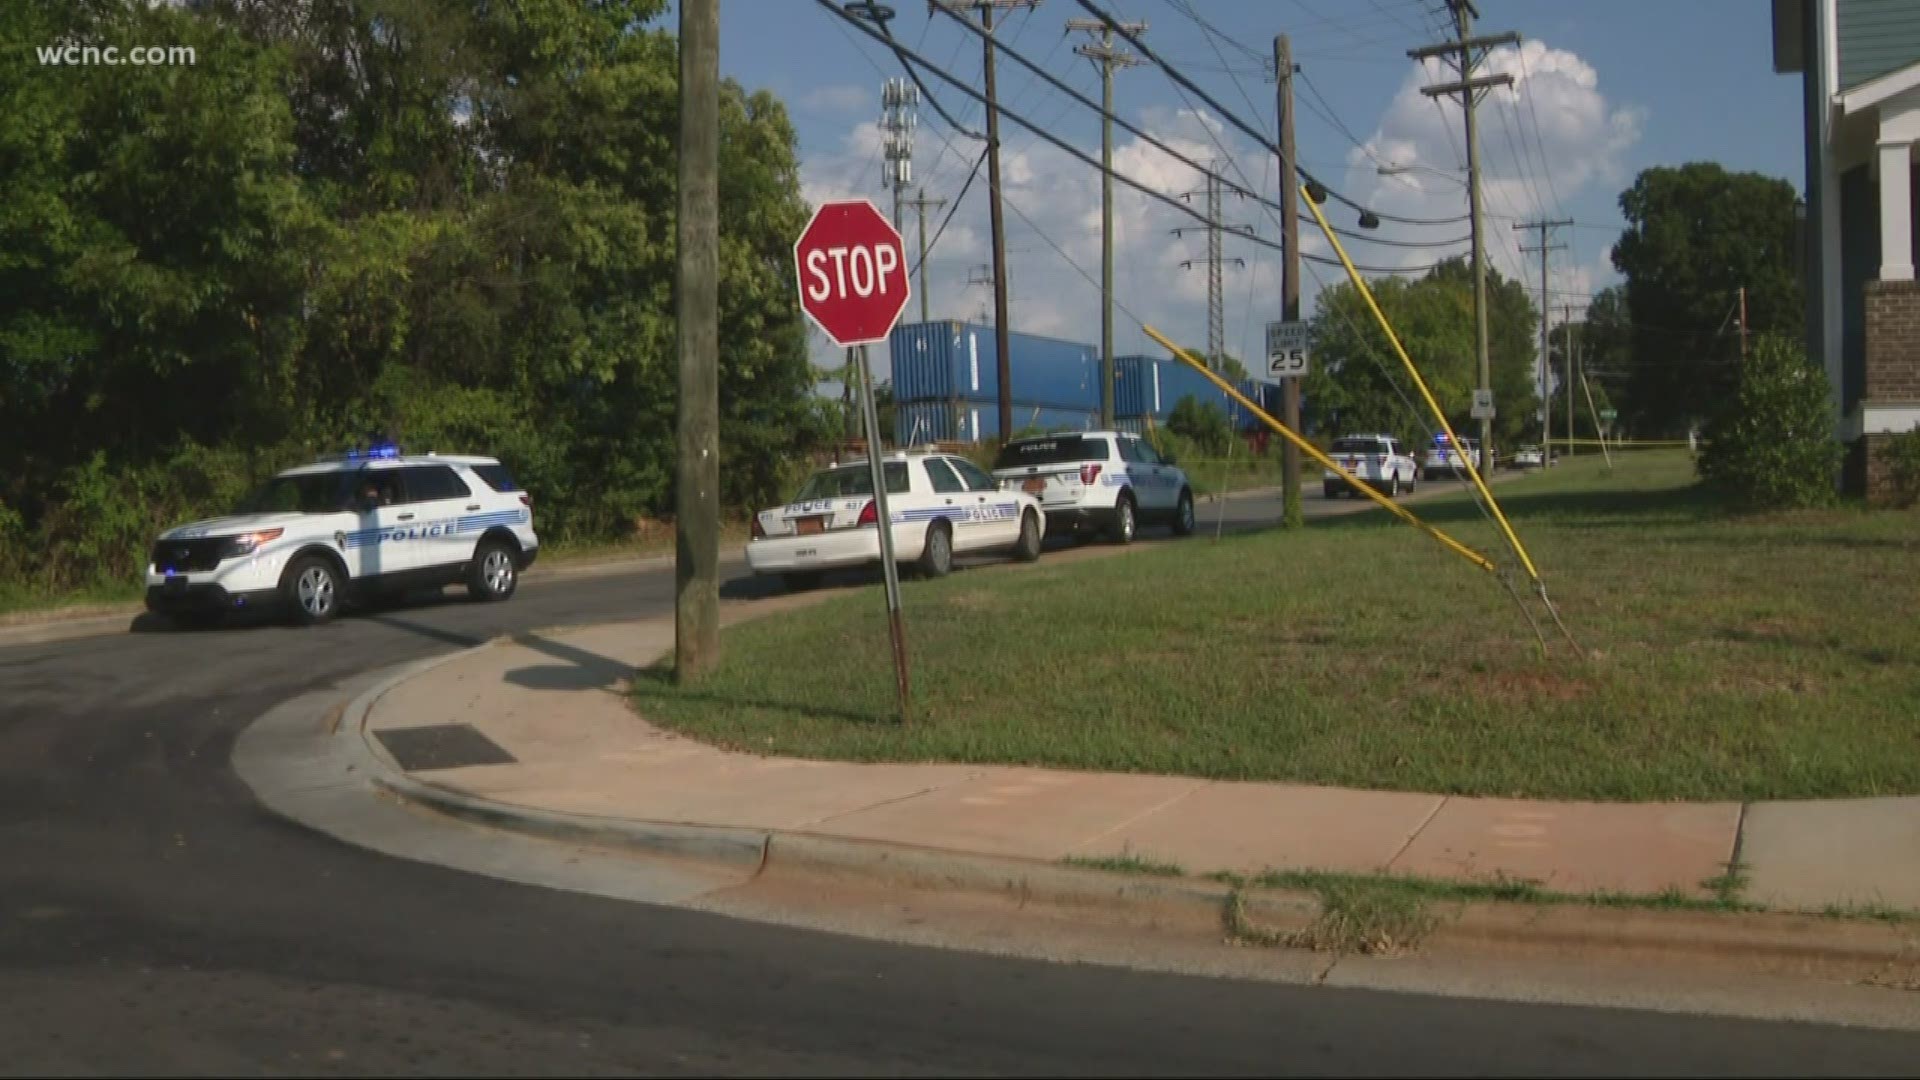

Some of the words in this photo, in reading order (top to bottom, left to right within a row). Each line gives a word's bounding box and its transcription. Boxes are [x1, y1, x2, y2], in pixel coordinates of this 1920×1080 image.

[806, 243, 898, 302] STOP
[1271, 350, 1304, 371] 25
[1020, 442, 1057, 453] POLICE
[784, 500, 832, 514] POLICE
[965, 508, 1006, 521] POLICE
[377, 524, 456, 543] POLICE
